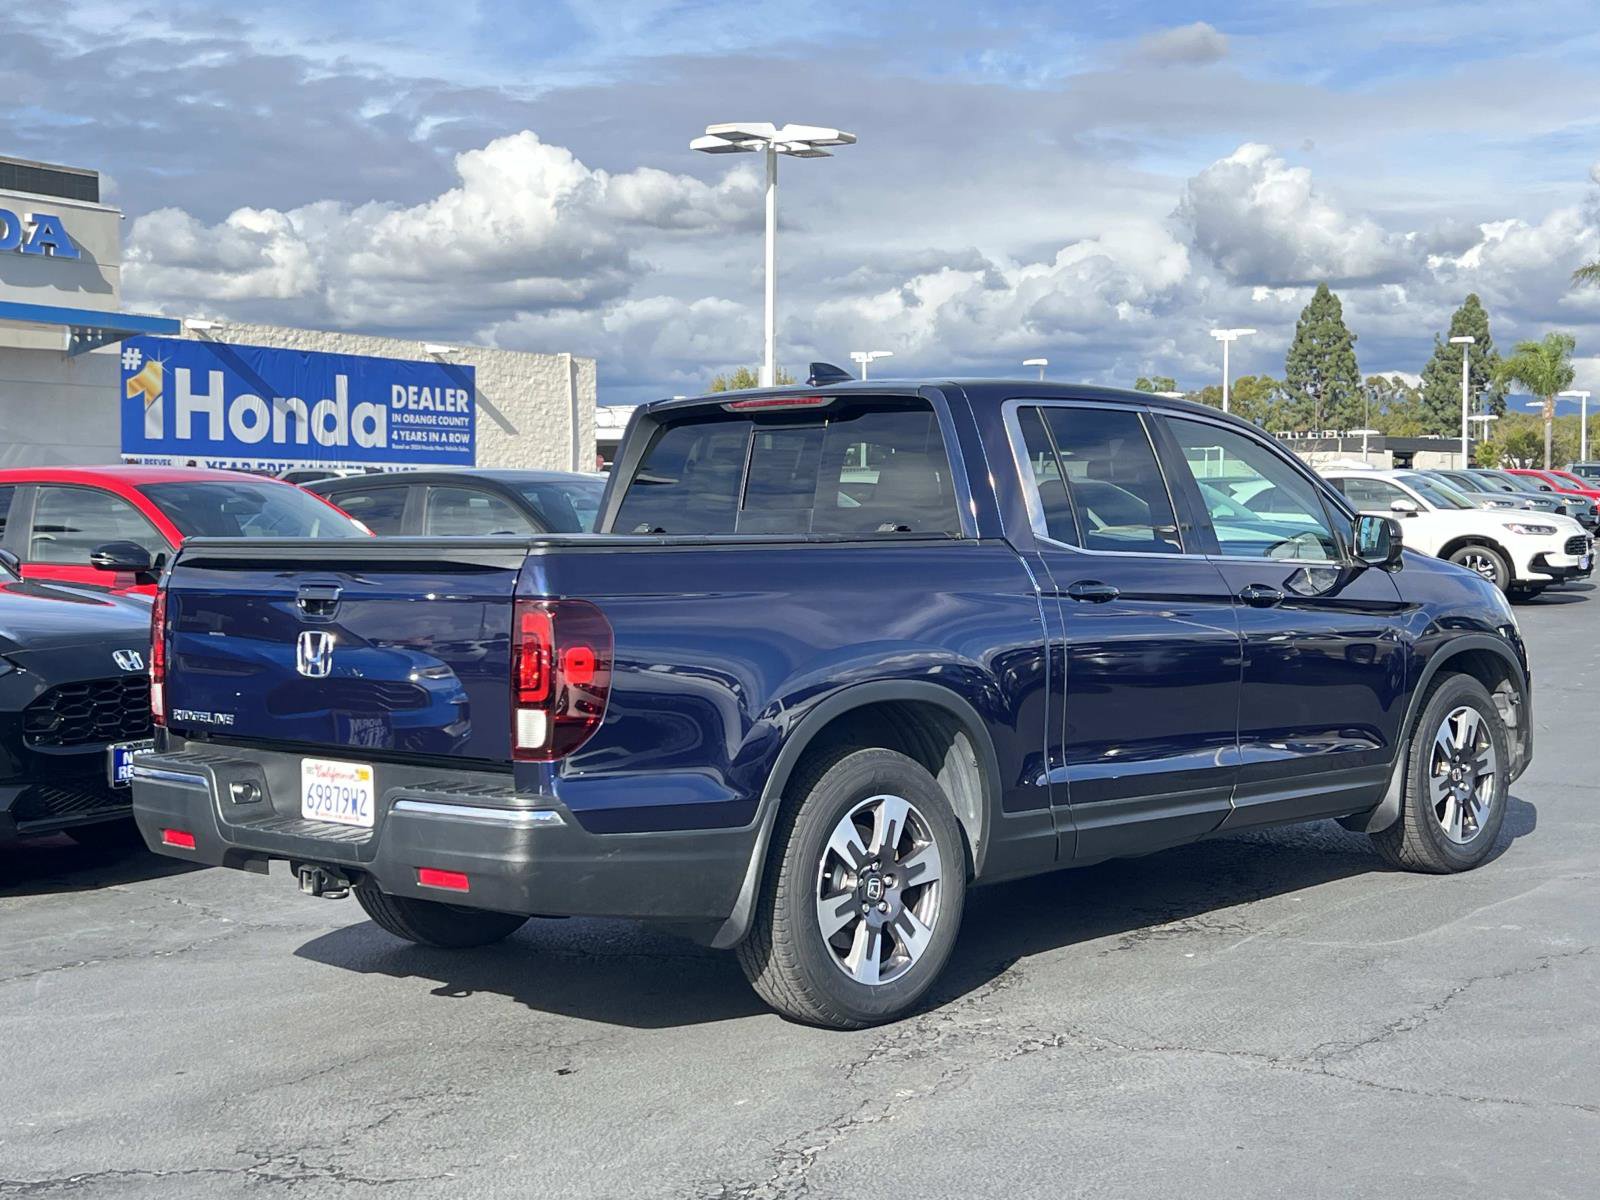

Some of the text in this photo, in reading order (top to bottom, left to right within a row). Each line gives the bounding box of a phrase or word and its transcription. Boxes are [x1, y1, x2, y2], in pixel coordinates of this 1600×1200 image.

[391, 384, 470, 413] DEALER
[175, 367, 388, 449] Honda
[392, 413, 470, 427] IN ORANGE COUNTY
[391, 430, 470, 444] 4 YEARS IN A ROW
[173, 708, 235, 725] RIDGELINE
